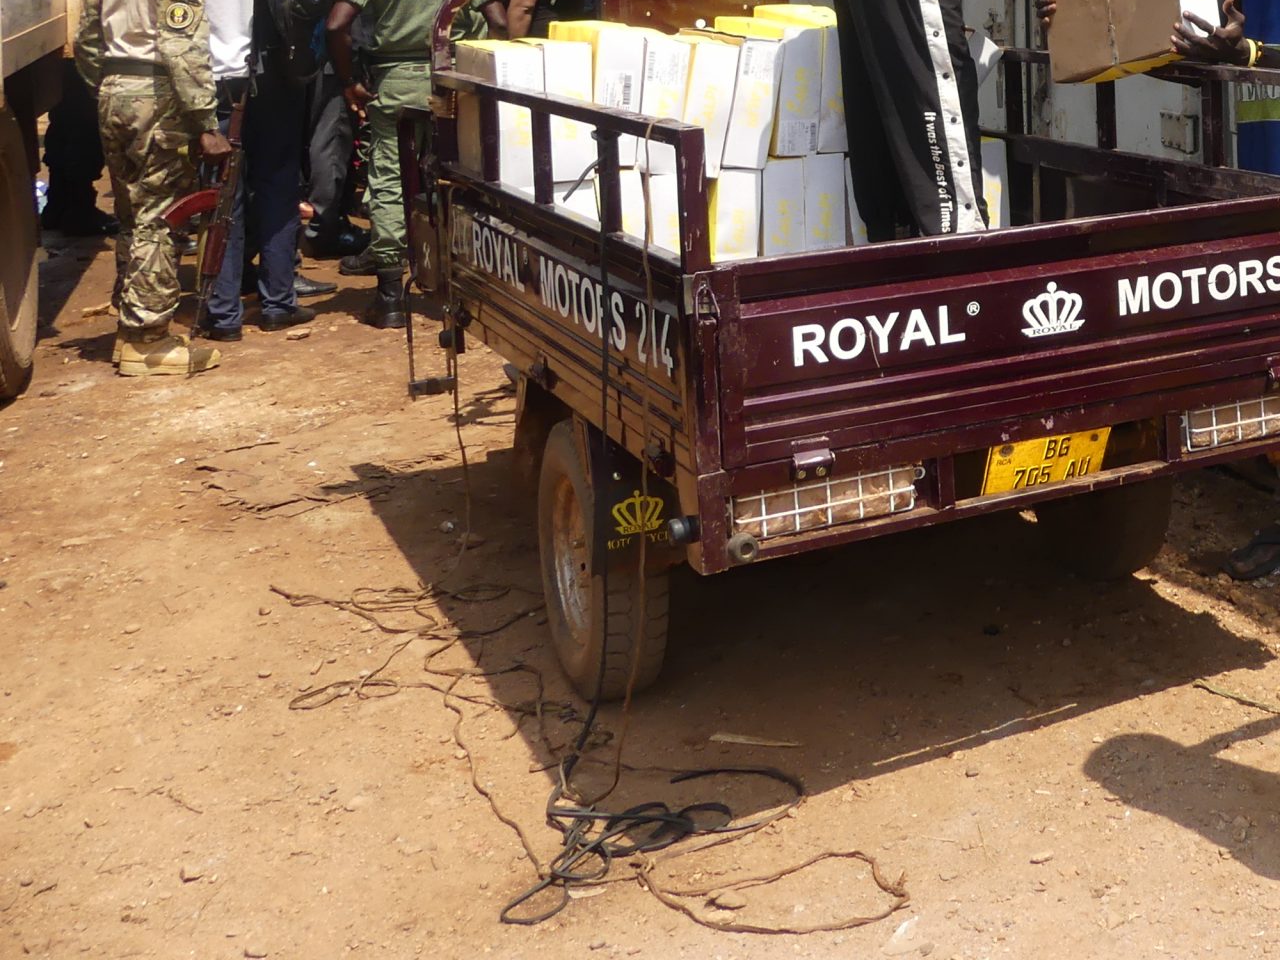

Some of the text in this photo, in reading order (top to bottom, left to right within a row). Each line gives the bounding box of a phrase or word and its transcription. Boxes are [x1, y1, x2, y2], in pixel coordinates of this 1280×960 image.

[925, 123, 938, 144] was
[930, 144, 944, 162] the
[938, 187, 953, 200] of
[940, 200, 955, 234] Times
[1032, 322, 1079, 337] ROYAL
[1043, 437, 1072, 461] BG
[1013, 456, 1091, 490] 705 AU
